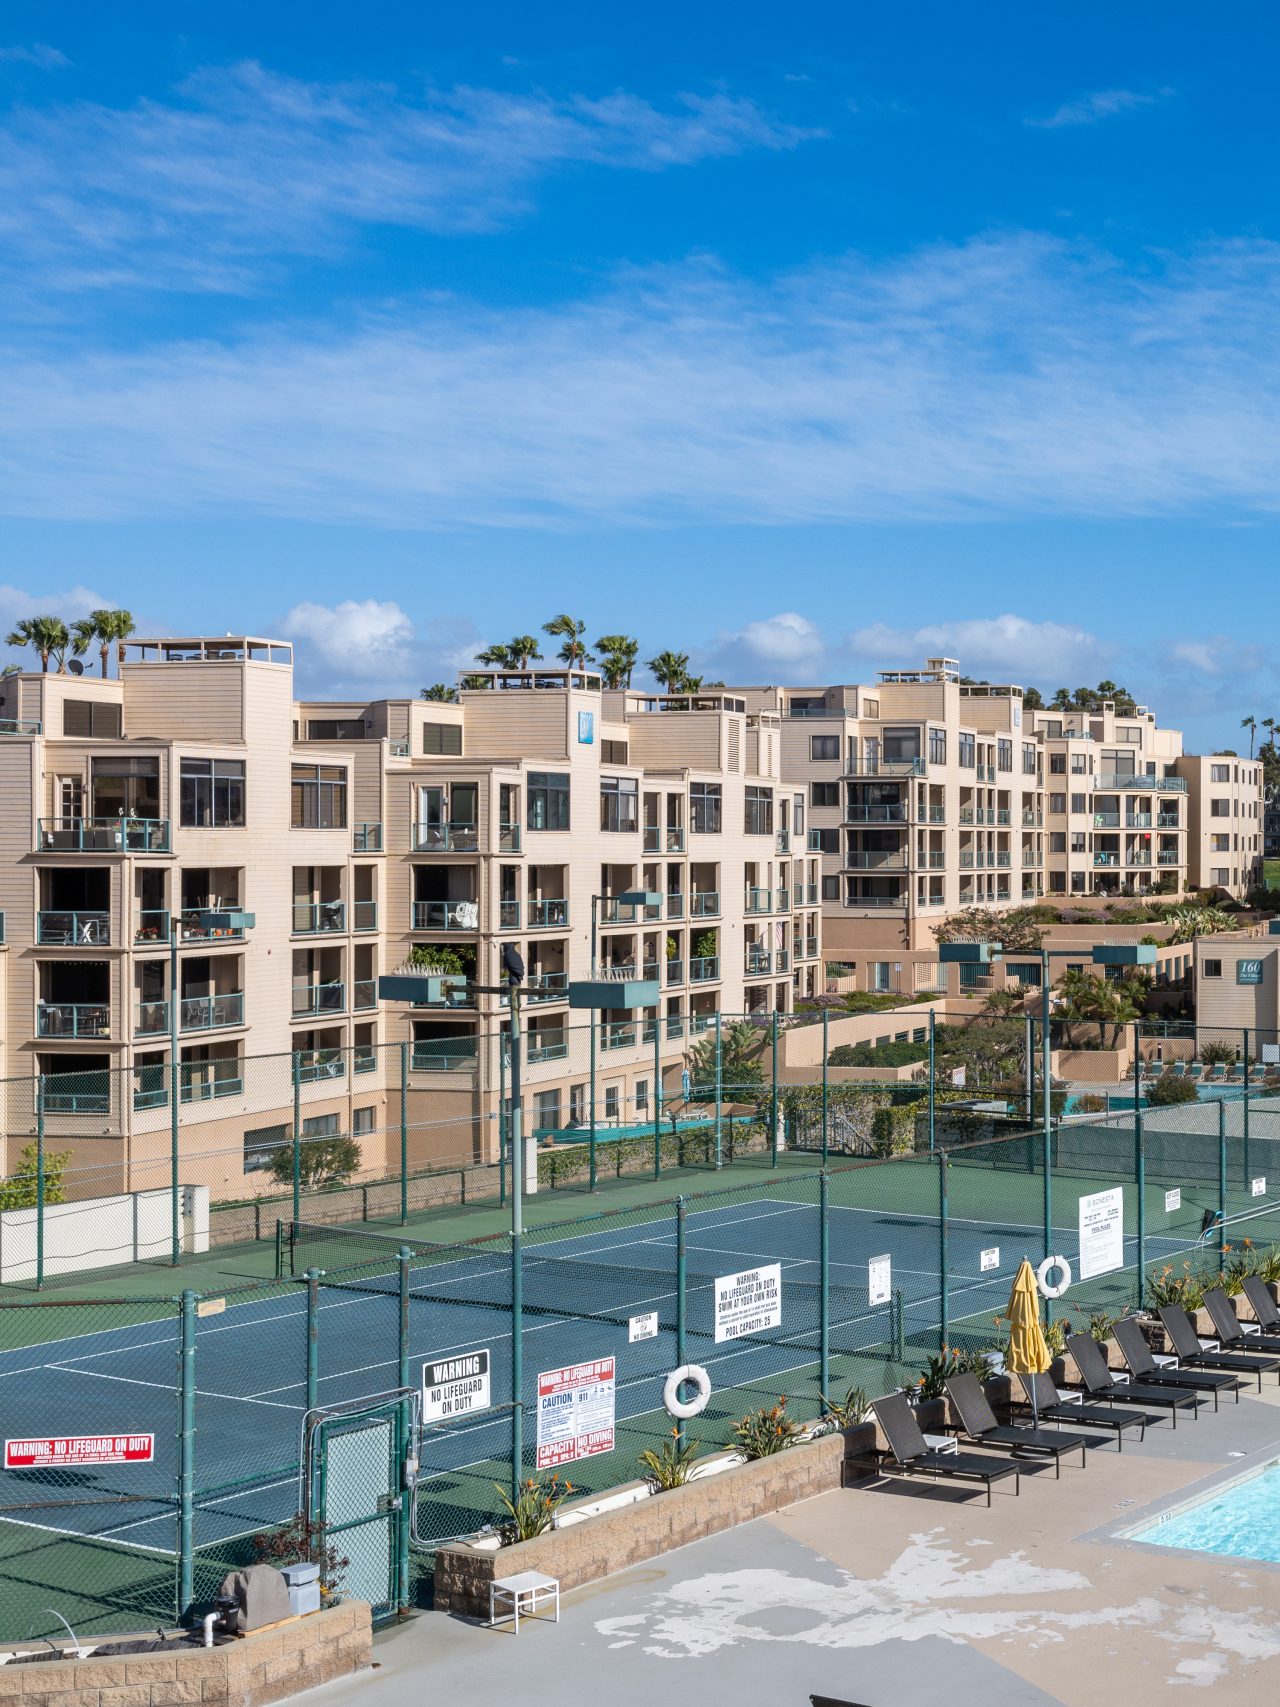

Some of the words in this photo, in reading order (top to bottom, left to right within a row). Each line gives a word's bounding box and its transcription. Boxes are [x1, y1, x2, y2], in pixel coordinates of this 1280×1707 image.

[1241, 962, 1260, 972] 160
[737, 1272, 760, 1286] WARNING:
[721, 1291, 727, 1301] NO
[729, 1284, 754, 1299] LIFEGUARD
[756, 1282, 762, 1291] ON
[764, 1278, 775, 1289] DUTY
[719, 1301, 732, 1312] SWIM
[734, 1298, 739, 1308] AT
[741, 1295, 752, 1306] YOUR
[754, 1292, 764, 1302] OWN
[766, 1288, 778, 1299] RISK
[726, 1326, 738, 1337] POOL
[740, 1318, 763, 1333] CAPACITY:
[765, 1316, 770, 1326] 25
[433, 1356, 480, 1383] WARNING
[541, 1372, 563, 1387] WARNING:
[564, 1370, 570, 1382] NO
[571, 1364, 594, 1380] LIFEGUARD
[594, 1363, 601, 1374] ON
[602, 1360, 612, 1373] DUTY
[432, 1389, 441, 1403] NO
[444, 1379, 482, 1399] LIFEGUARD
[542, 1392, 572, 1409] CAUTION
[579, 1393, 588, 1402] 911
[443, 1400, 452, 1414] ON
[455, 1395, 472, 1411] DUTY
[10, 1442, 52, 1456] WARNING:
[54, 1442, 66, 1455] NO
[69, 1440, 112, 1454] LIFEGUARD
[115, 1438, 126, 1452] ON
[129, 1437, 150, 1451] DUTY
[578, 1436, 588, 1448] NO
[589, 1429, 612, 1444] DIVING
[540, 1439, 574, 1458] CAPACITY
